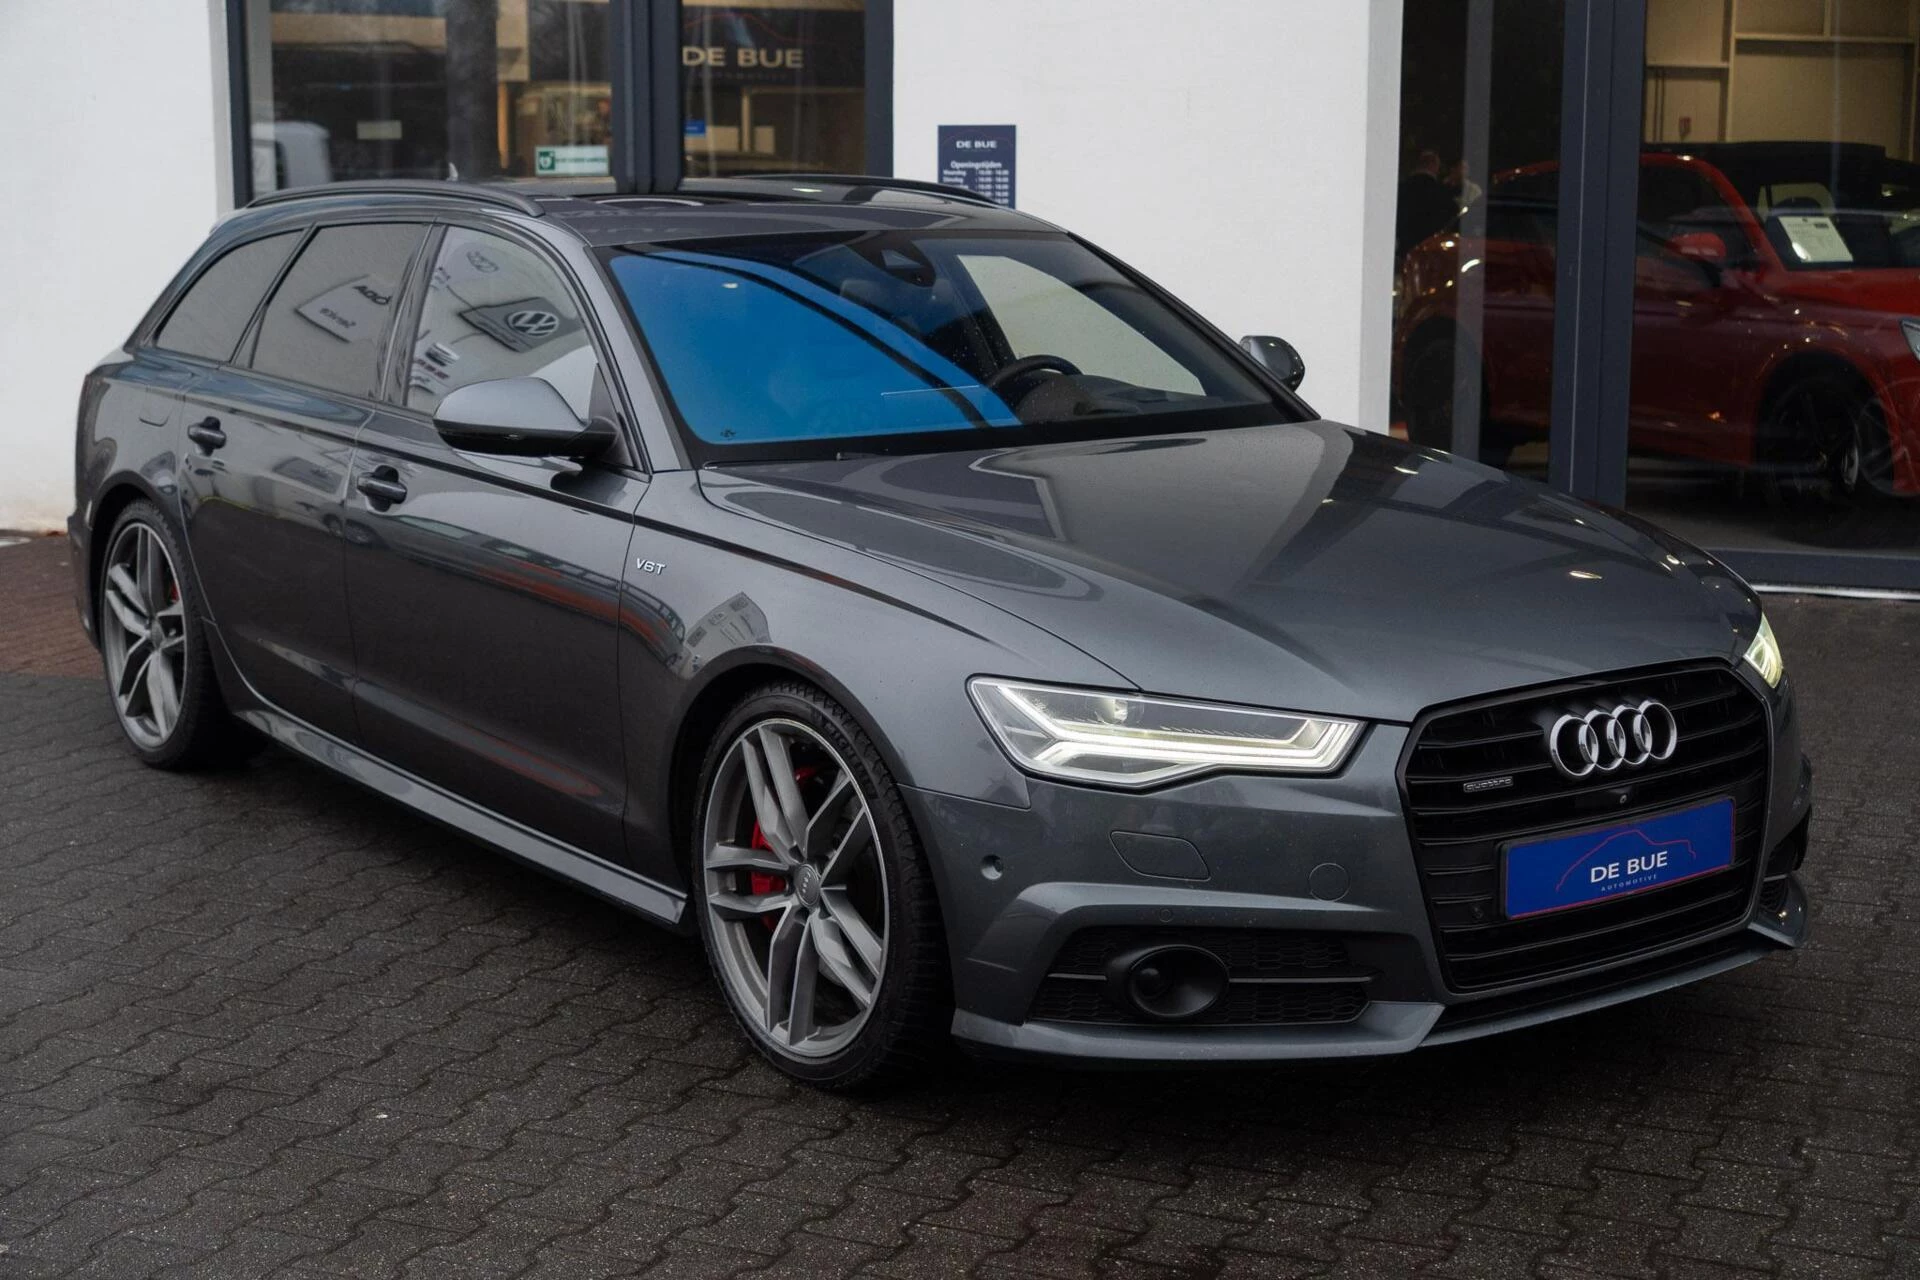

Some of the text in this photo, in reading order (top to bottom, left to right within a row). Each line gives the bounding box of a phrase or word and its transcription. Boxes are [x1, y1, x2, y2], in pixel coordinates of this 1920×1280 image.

[682, 46, 804, 69] DE BUE
[956, 140, 998, 149] DE BUE
[636, 558, 667, 575] V6T
[1590, 850, 1668, 883] DE BUE
[1601, 873, 1657, 892] AUTOMOTIVE
